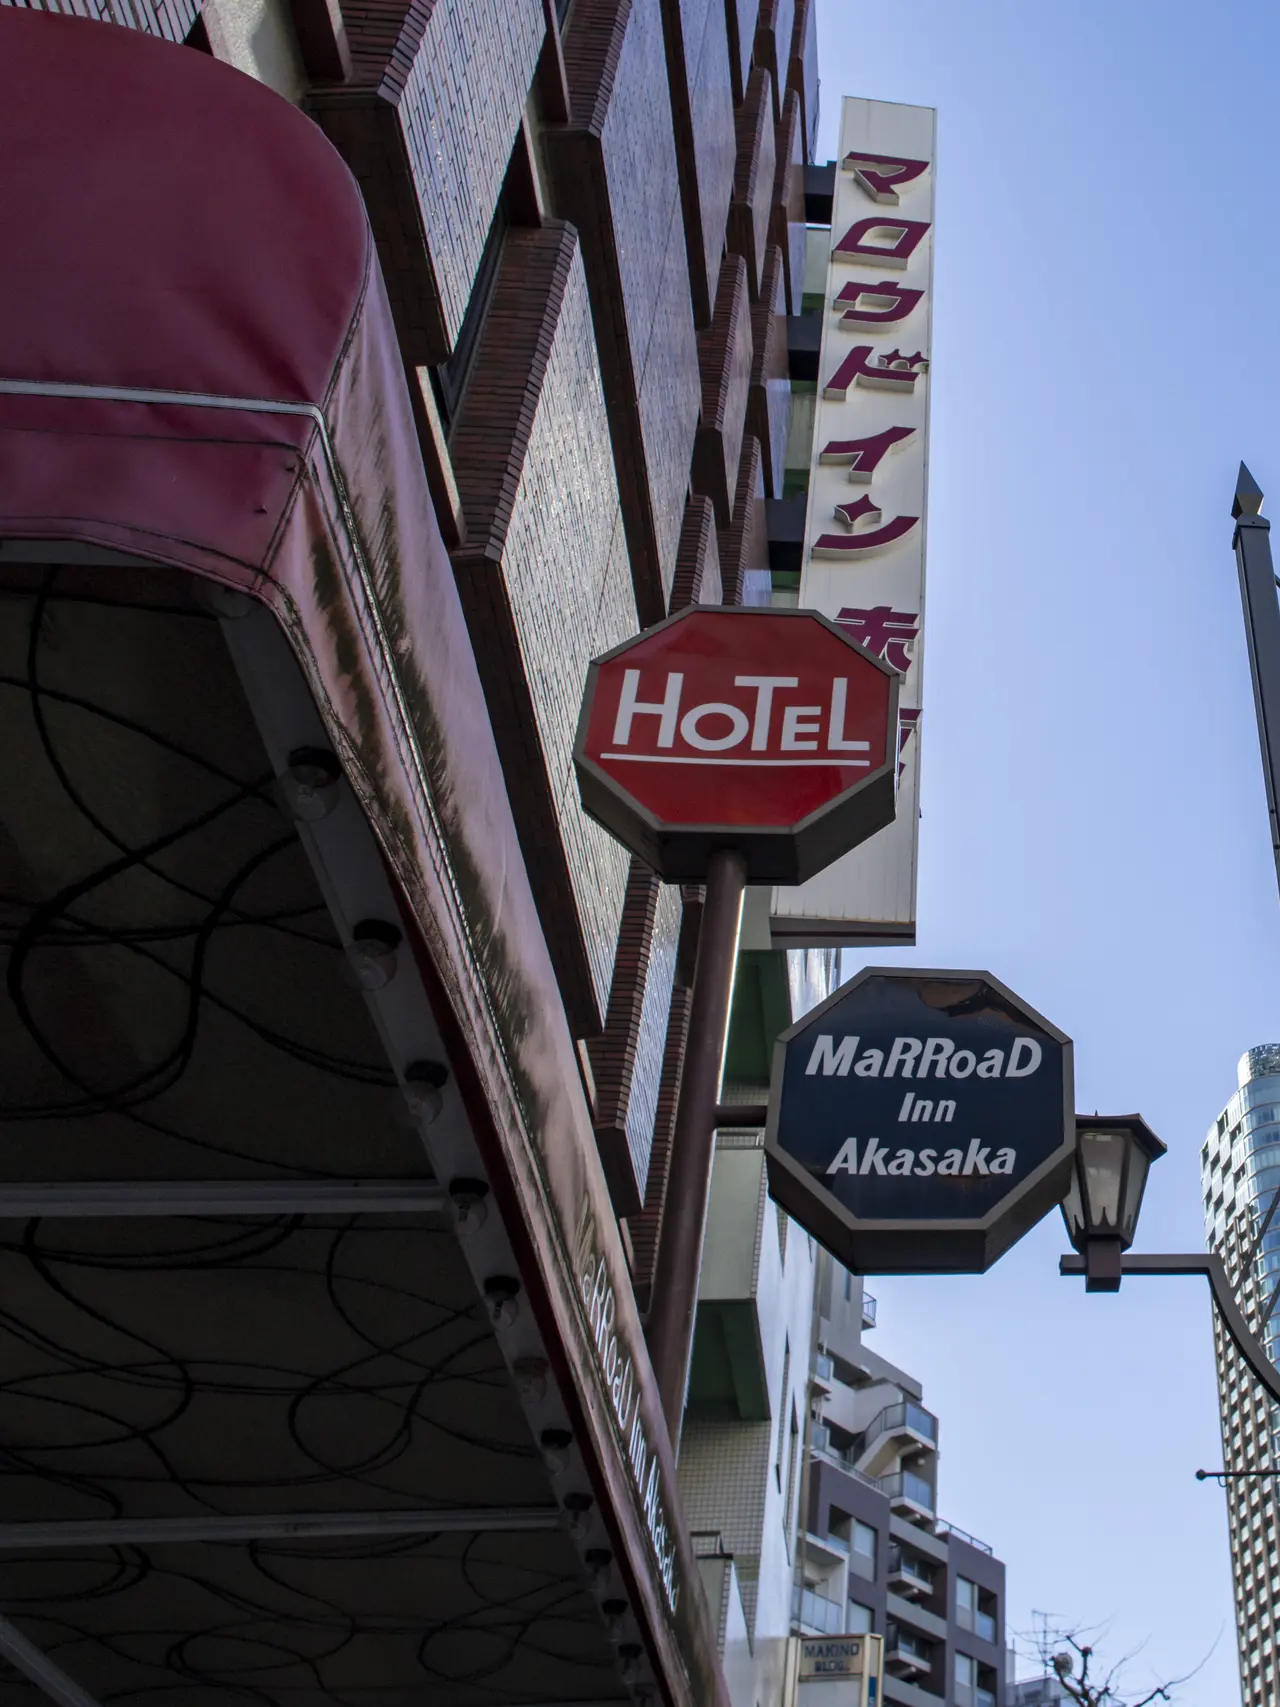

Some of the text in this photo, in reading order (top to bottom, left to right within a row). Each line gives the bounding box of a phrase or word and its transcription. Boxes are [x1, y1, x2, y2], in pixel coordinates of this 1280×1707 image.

[805, 1035, 1042, 1079] MaRRoaD
[898, 1092, 957, 1123] Inn
[826, 1137, 1016, 1176] Akasaka
